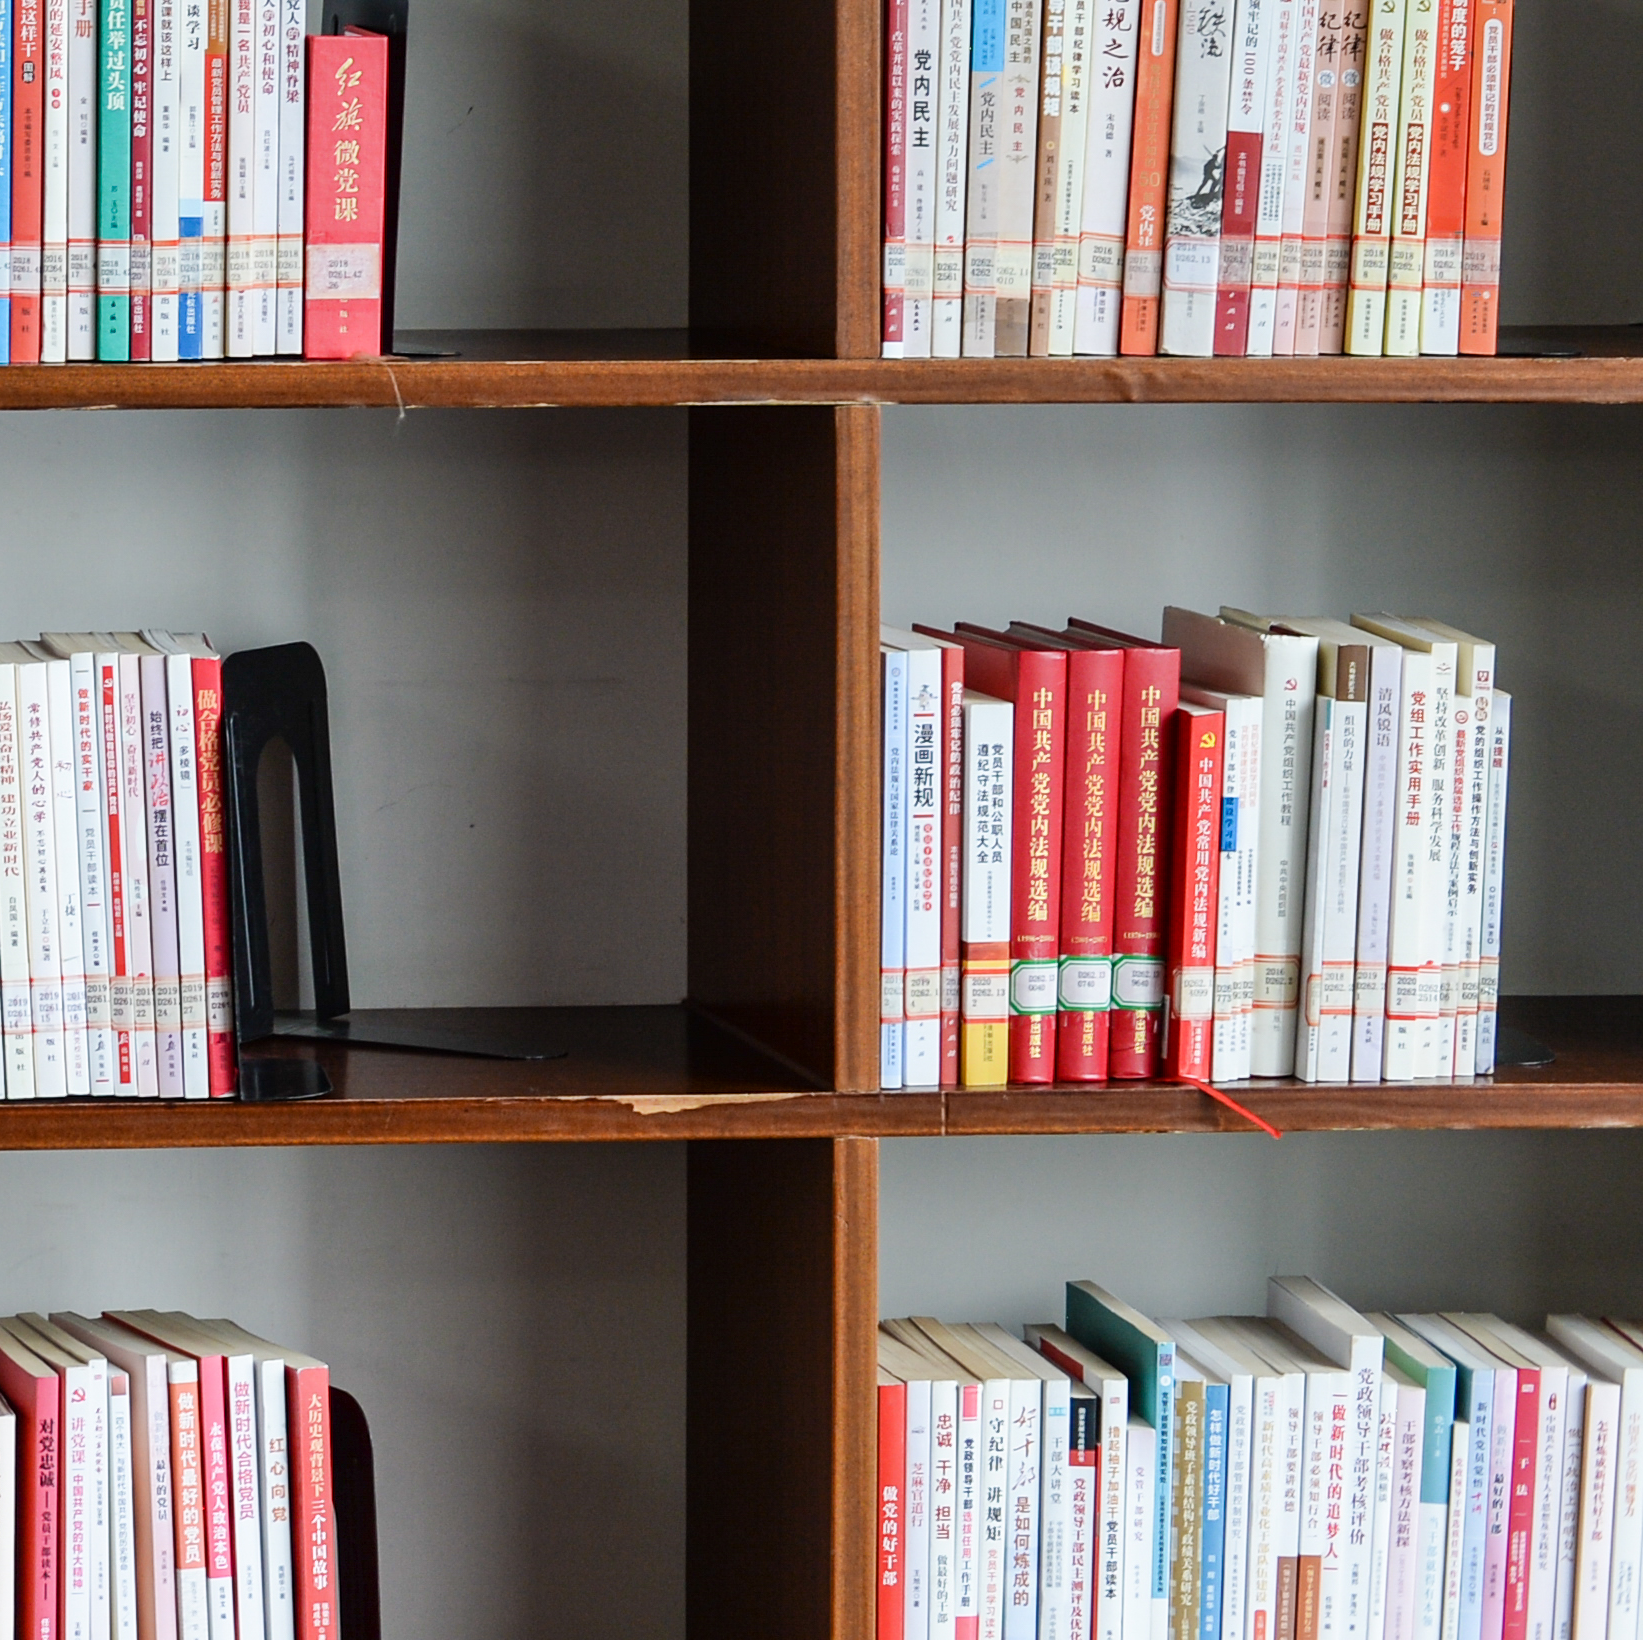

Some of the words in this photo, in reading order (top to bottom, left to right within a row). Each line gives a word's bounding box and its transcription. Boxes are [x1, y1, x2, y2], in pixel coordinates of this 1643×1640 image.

[331, 58, 362, 221] 红旗微党课
[912, 49, 931, 148] 党内民主
[913, 724, 934, 807] 漫画新规
[1028, 687, 1053, 921] 中国共产党党内法规选编
[1081, 690, 1107, 922] 中国共产党党内法规选编
[1134, 686, 1161, 919] 中国共产党党内法规选编
[177, 1392, 201, 1563] 做新时代最好的党员
[881, 1486, 898, 1587] 做党的好干部
